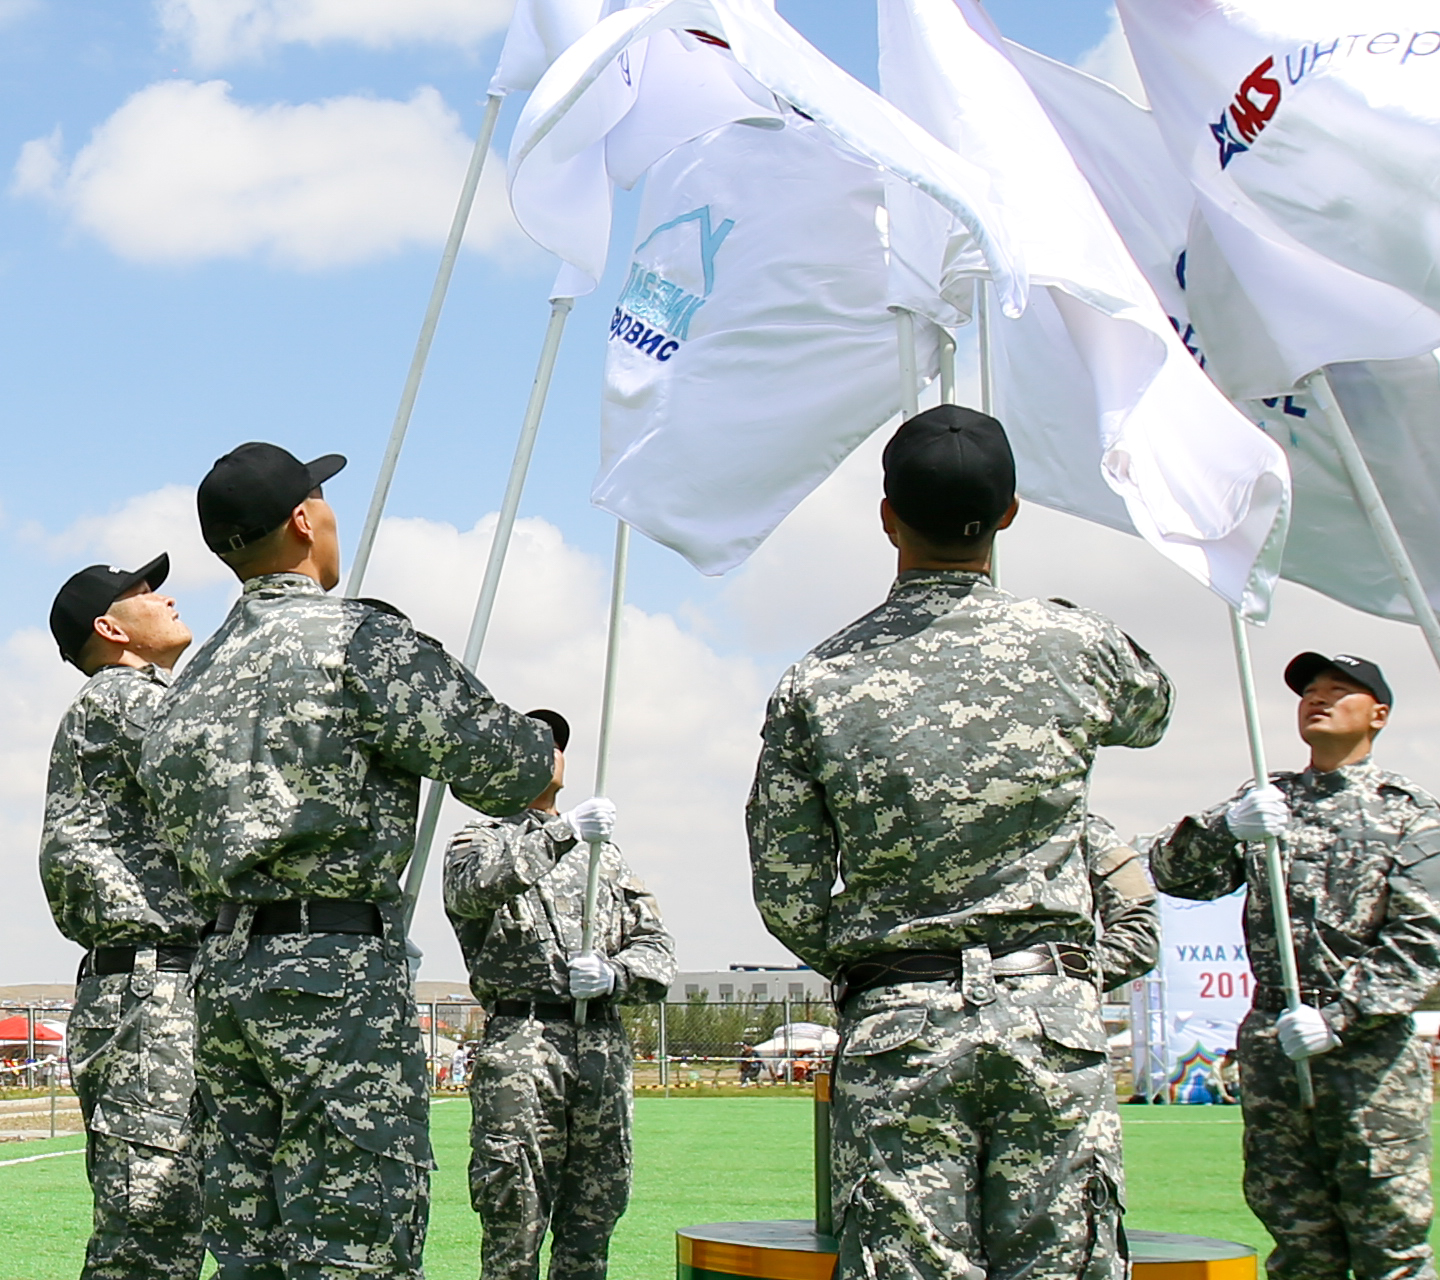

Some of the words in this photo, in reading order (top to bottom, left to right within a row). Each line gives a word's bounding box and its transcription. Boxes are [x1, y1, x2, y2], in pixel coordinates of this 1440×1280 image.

[1176, 944, 1227, 961] УХАА
[1232, 944, 1246, 961] Х
[1200, 972, 1250, 998] 201
